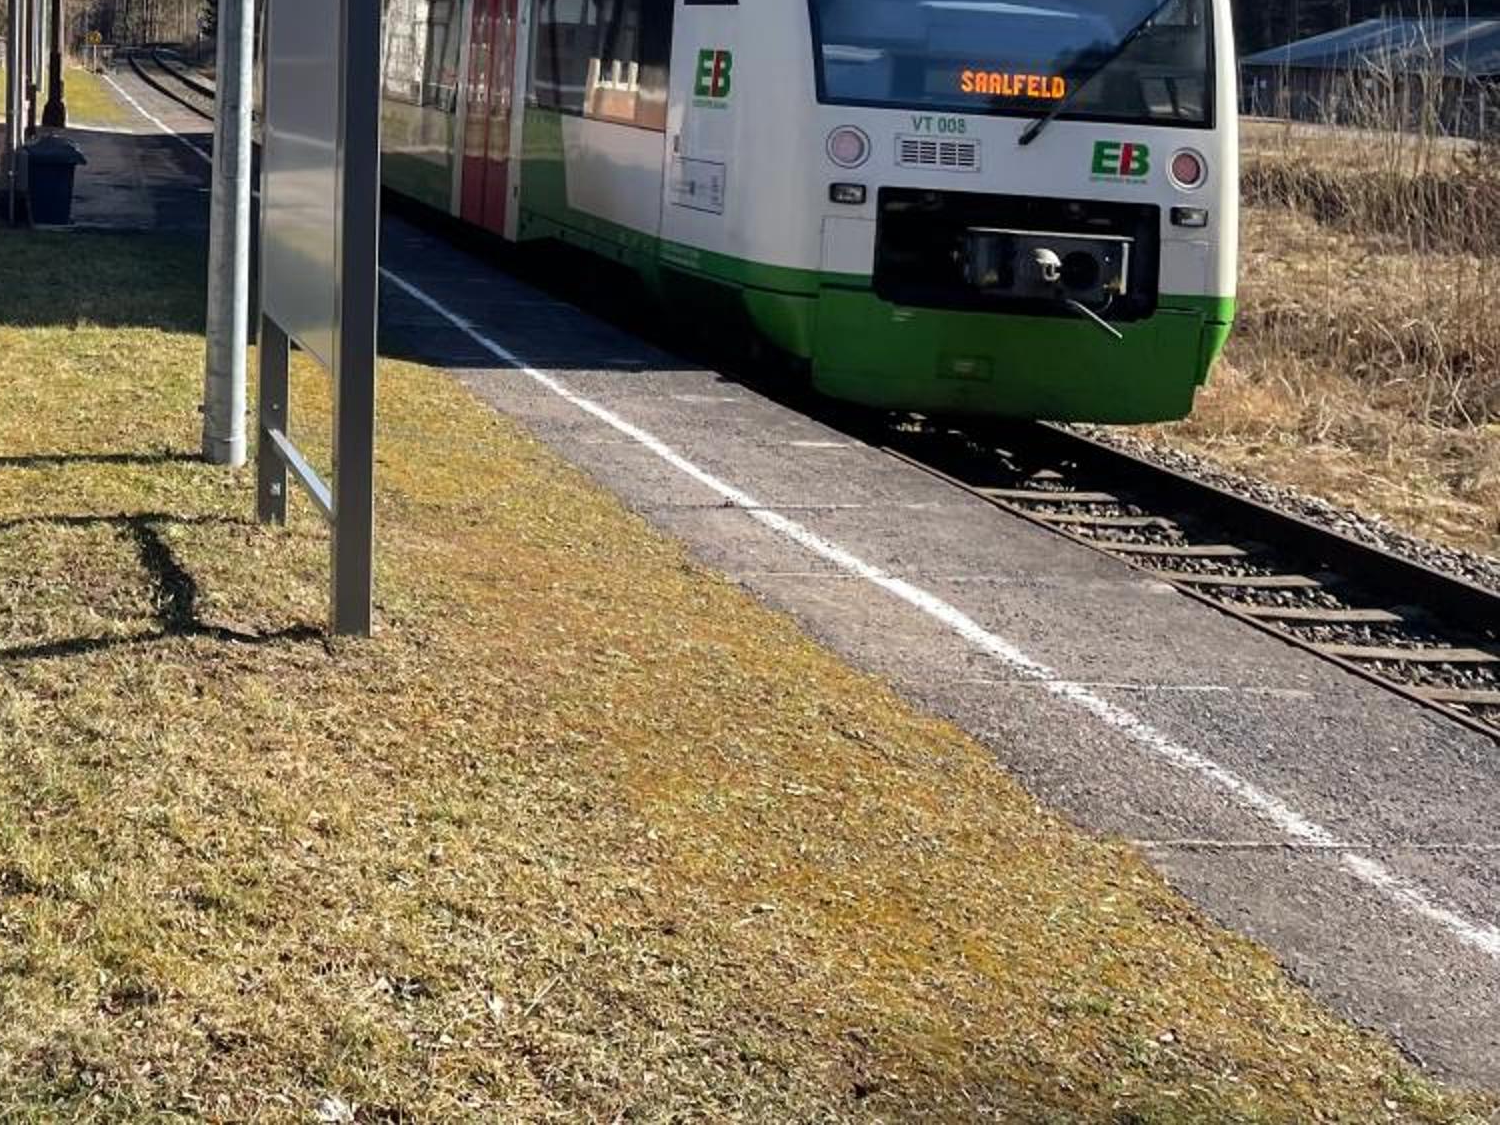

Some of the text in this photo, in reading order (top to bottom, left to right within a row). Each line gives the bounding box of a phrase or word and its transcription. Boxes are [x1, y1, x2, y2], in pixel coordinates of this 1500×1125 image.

[695, 49, 732, 97] EB
[961, 69, 1066, 99] SAALFELD
[911, 115, 967, 134] VT 008
[1091, 140, 1150, 177] EB
